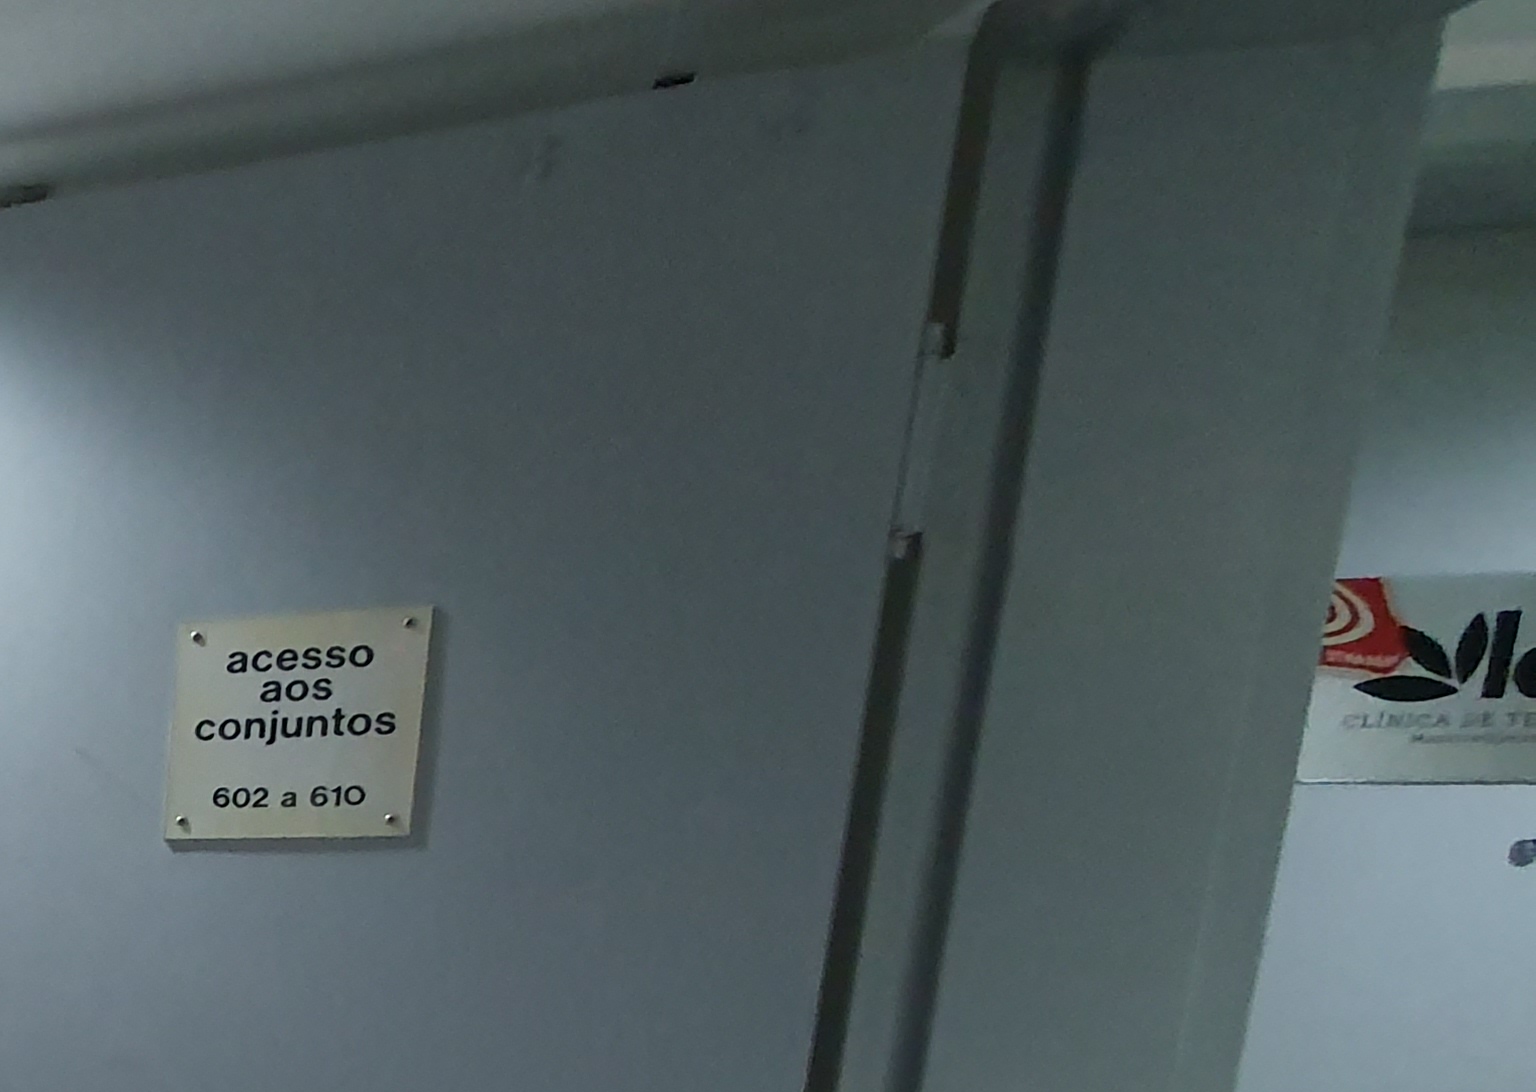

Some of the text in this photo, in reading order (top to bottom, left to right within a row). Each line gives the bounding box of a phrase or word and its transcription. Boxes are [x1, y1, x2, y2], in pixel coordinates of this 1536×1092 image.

[225, 644, 375, 674] acesso
[259, 677, 334, 703] aos
[194, 707, 397, 746] conjuntos
[212, 784, 366, 809] 602 a 610
